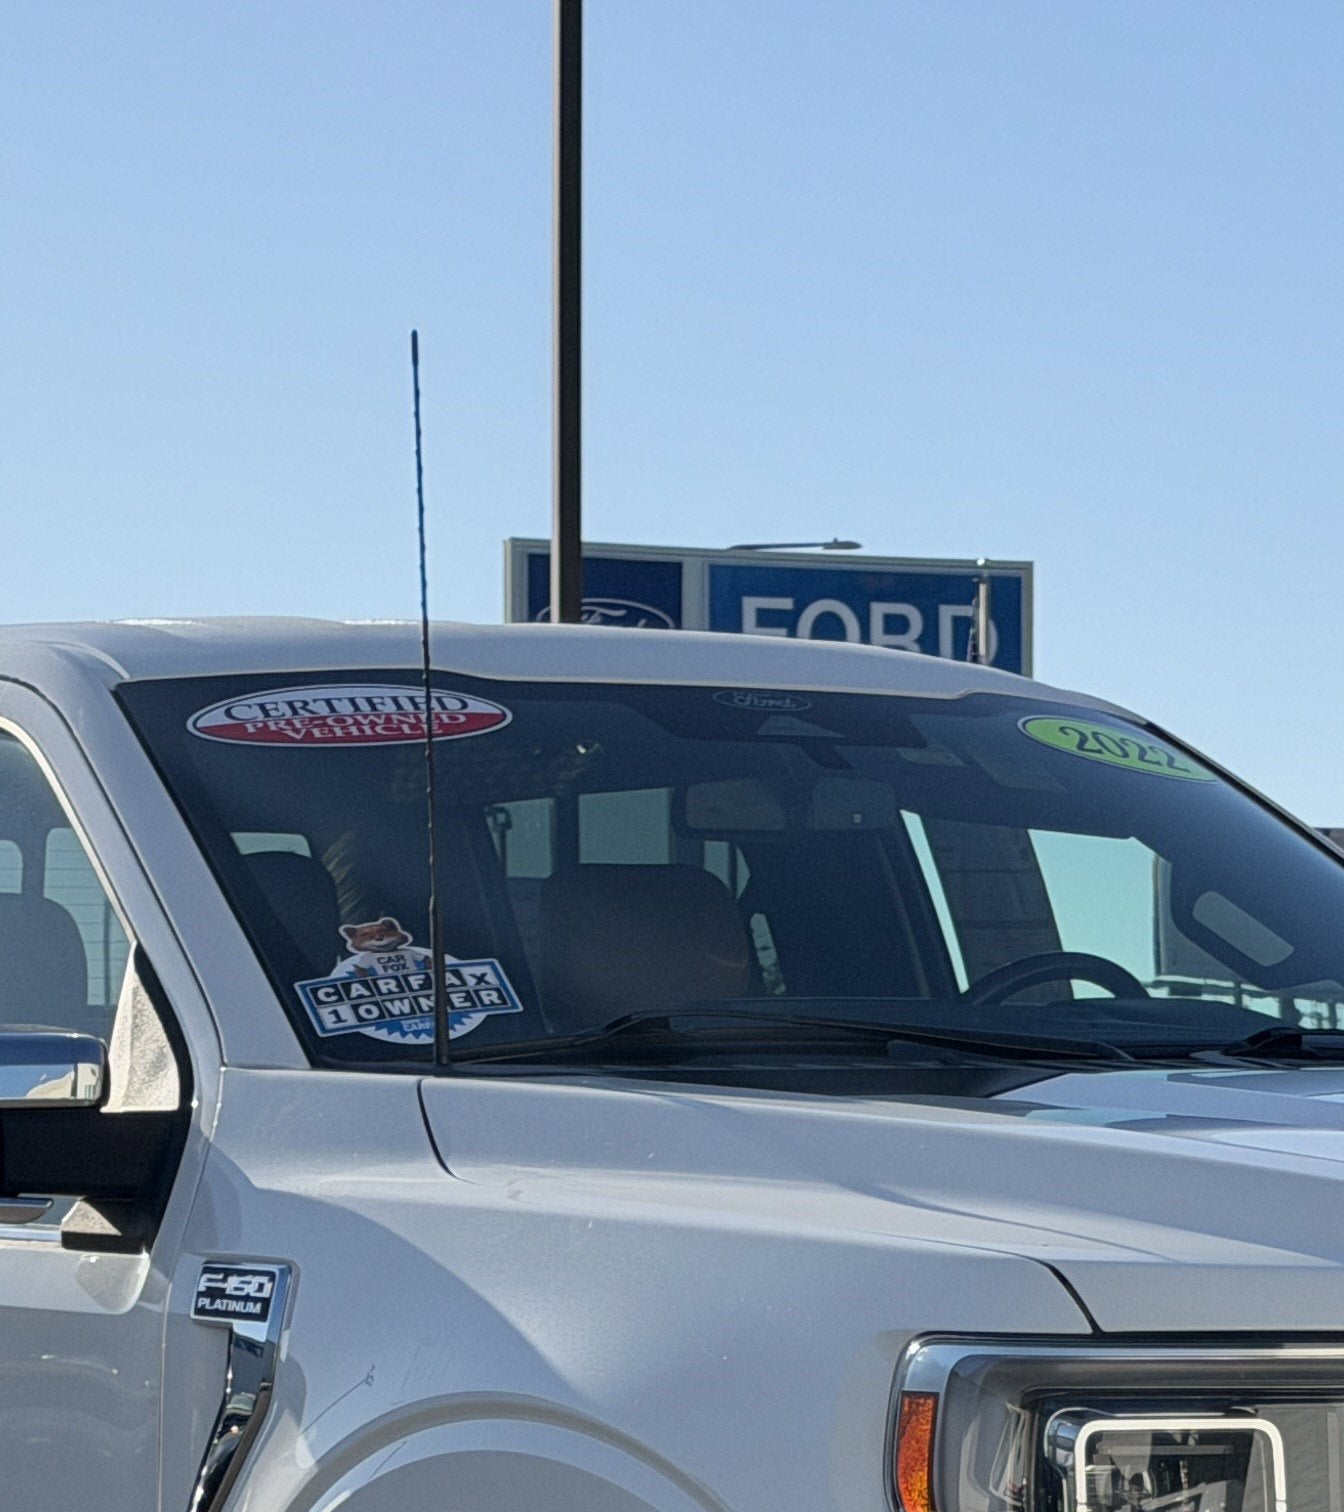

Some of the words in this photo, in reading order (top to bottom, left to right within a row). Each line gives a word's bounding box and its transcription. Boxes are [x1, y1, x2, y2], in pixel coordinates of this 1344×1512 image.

[741, 595, 998, 664] FORD
[224, 695, 469, 721] CERTIFIED
[244, 711, 467, 734] PRE-OWNED
[282, 723, 443, 740] VEHICLE
[1058, 726, 1192, 773] 2022
[316, 969, 494, 1002] CARFAX
[327, 1010, 348, 1024] 1
[357, 990, 503, 1020] OWNER
[197, 1297, 262, 1314] PLATINUM
